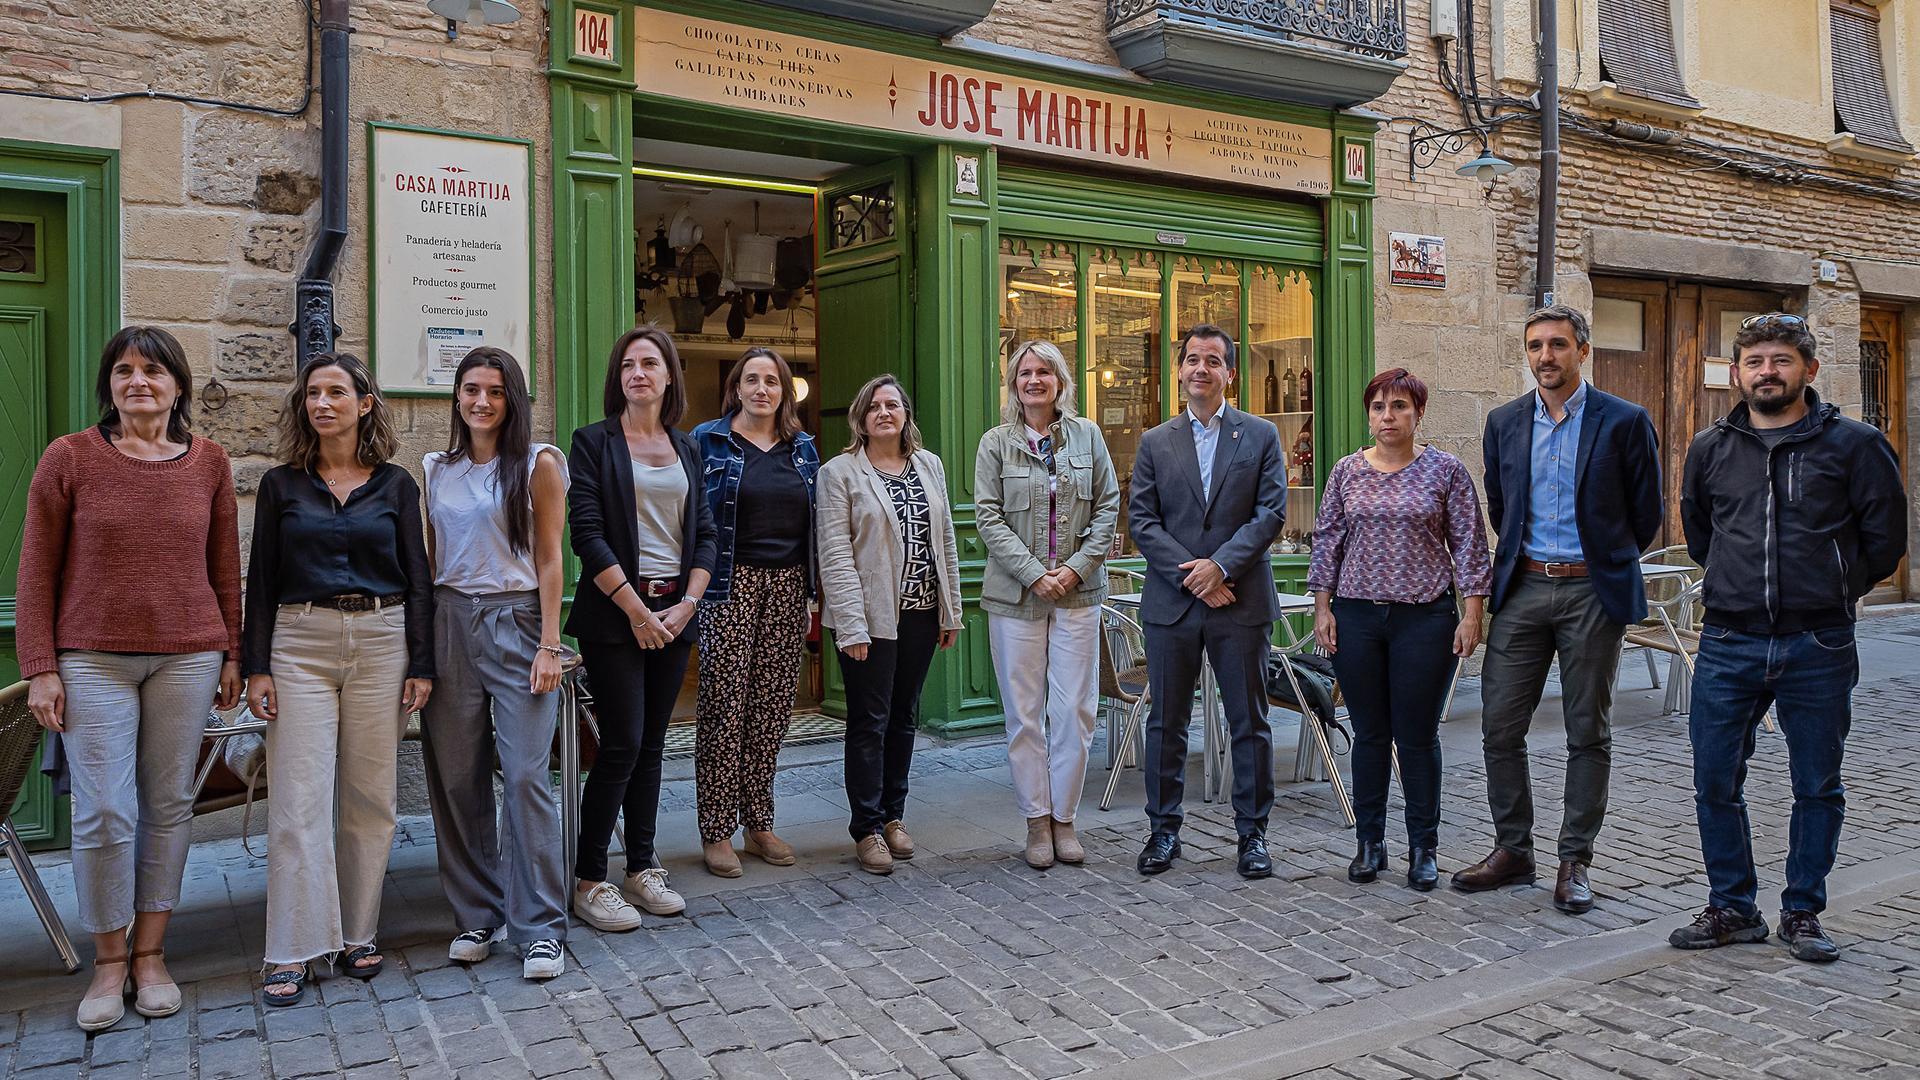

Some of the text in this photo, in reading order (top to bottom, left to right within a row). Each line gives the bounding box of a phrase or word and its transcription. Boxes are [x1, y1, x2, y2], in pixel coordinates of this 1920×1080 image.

[579, 14, 608, 56] 104
[684, 26, 842, 64] CHOCOLATES CERAS
[716, 48, 815, 75] CAFES THES
[674, 58, 854, 100] GALLETAS CONSERVAS
[917, 70, 1150, 160] JOSE MARTIJA
[1206, 119, 1303, 142] ACEITES ESPECIAS
[1194, 130, 1307, 156] LEGUMBRES TAPIOCAS
[1209, 146, 1298, 168] JABONES MIXTOS
[1347, 147, 1364, 177] 104
[1230, 164, 1281, 180] BACALAOS
[395, 173, 511, 202] CASA MARTIJA
[420, 200, 488, 218] CAFETERÍA
[406, 234, 502, 251] Panadería y heladería
[432, 252, 477, 263] artesanas
[412, 276, 497, 292] Productos gourmet
[421, 304, 488, 318] Comercio justo
